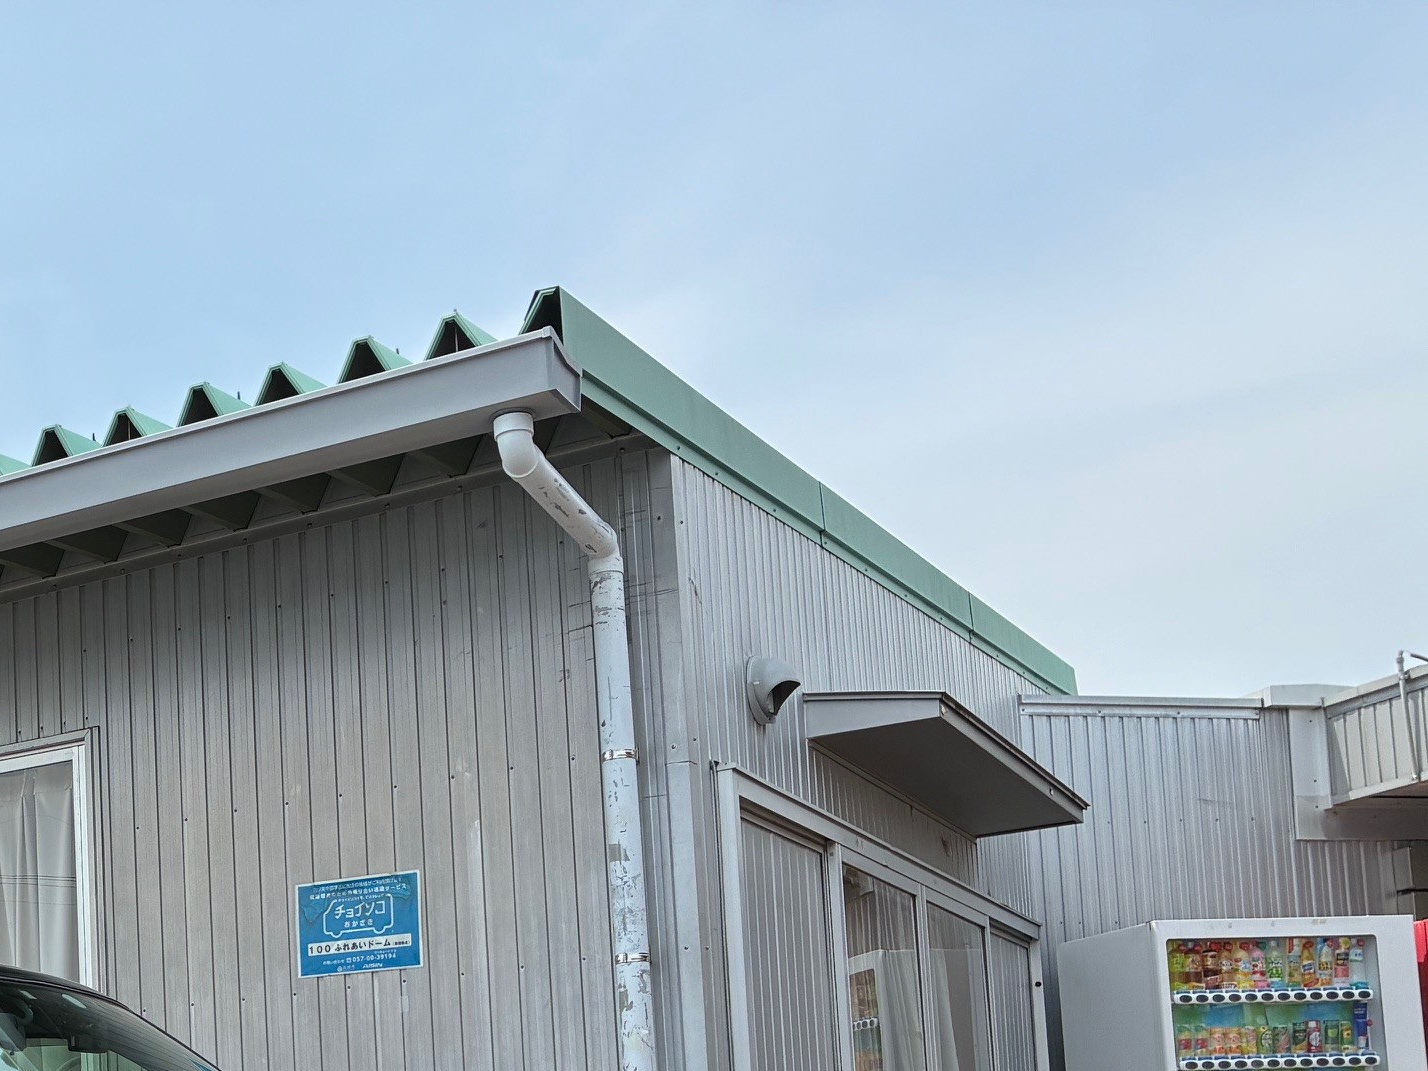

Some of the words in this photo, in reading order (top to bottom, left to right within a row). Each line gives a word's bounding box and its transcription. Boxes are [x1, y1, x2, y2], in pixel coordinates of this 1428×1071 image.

[335, 900, 385, 919] チョイソコ
[344, 919, 374, 928] おかざき
[335, 939, 391, 952] ふれあいドーム
